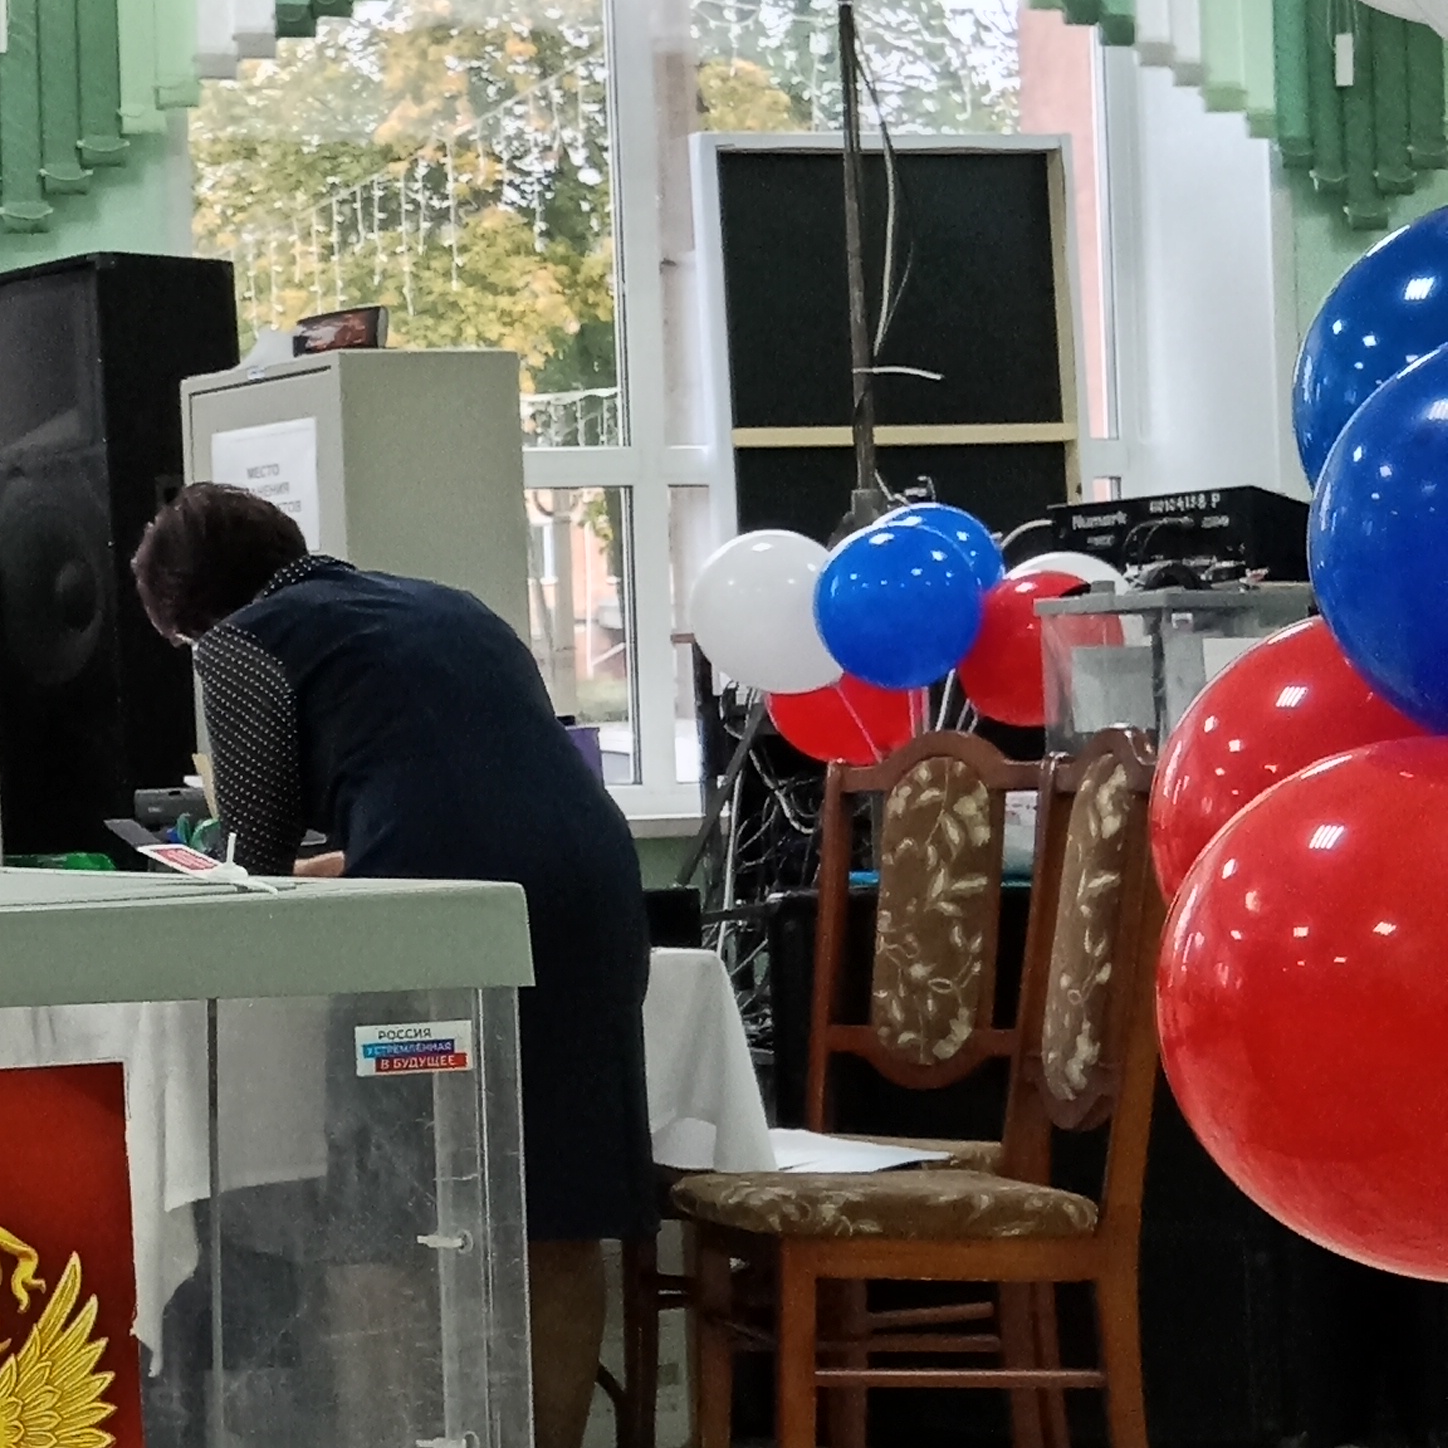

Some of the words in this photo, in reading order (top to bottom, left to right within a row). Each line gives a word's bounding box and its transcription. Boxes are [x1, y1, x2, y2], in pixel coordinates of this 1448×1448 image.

[247, 464, 279, 479] МЕСТО
[378, 1028, 432, 1039] РОССИЯ
[381, 1059, 390, 1069] В
[393, 1055, 457, 1069] БУДУЩЕЕ
